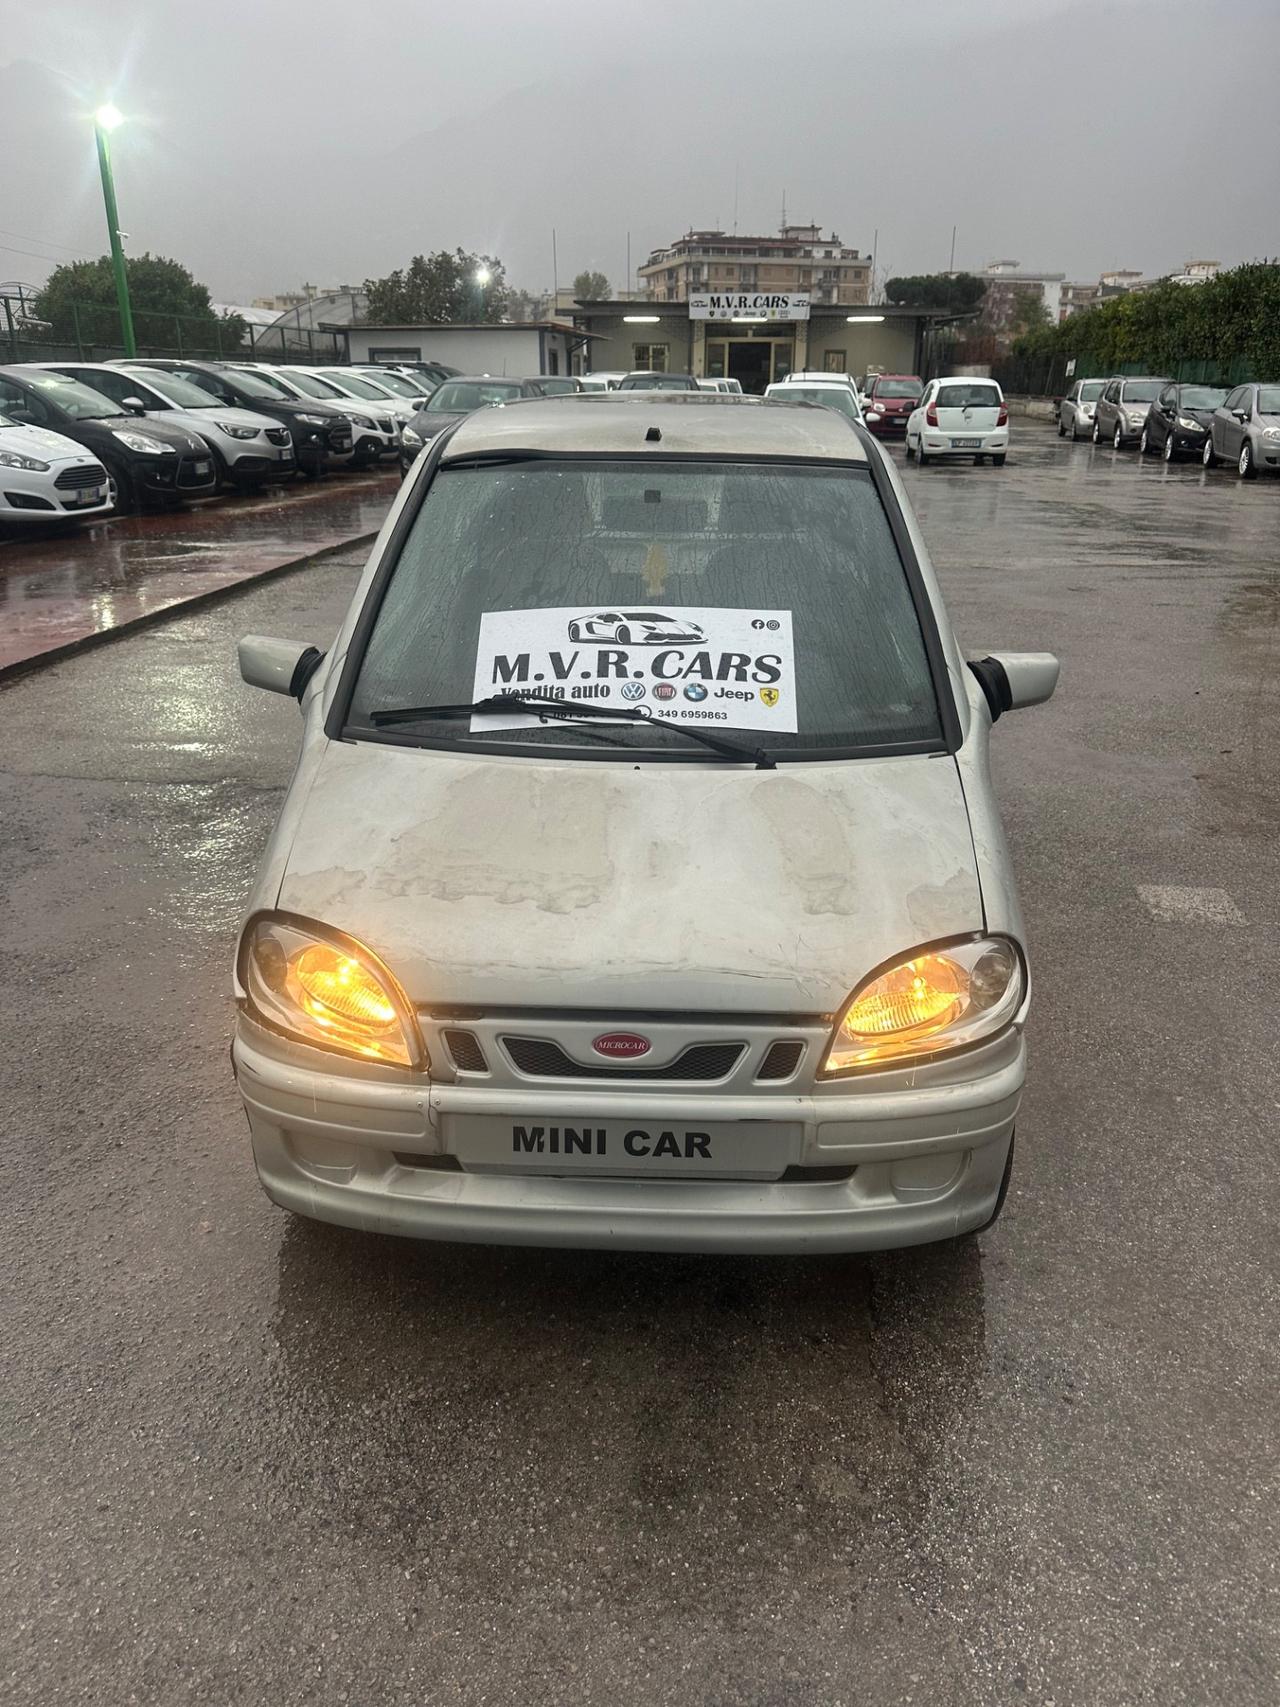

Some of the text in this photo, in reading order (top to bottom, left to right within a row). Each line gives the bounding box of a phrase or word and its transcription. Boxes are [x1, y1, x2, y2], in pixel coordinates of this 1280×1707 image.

[571, 683, 610, 698] auto
[714, 687, 755, 702] Jeep
[657, 709, 728, 720] 349 6959863
[598, 1040, 646, 1050] MICROCAR
[513, 1126, 712, 1158] MINI CAR
